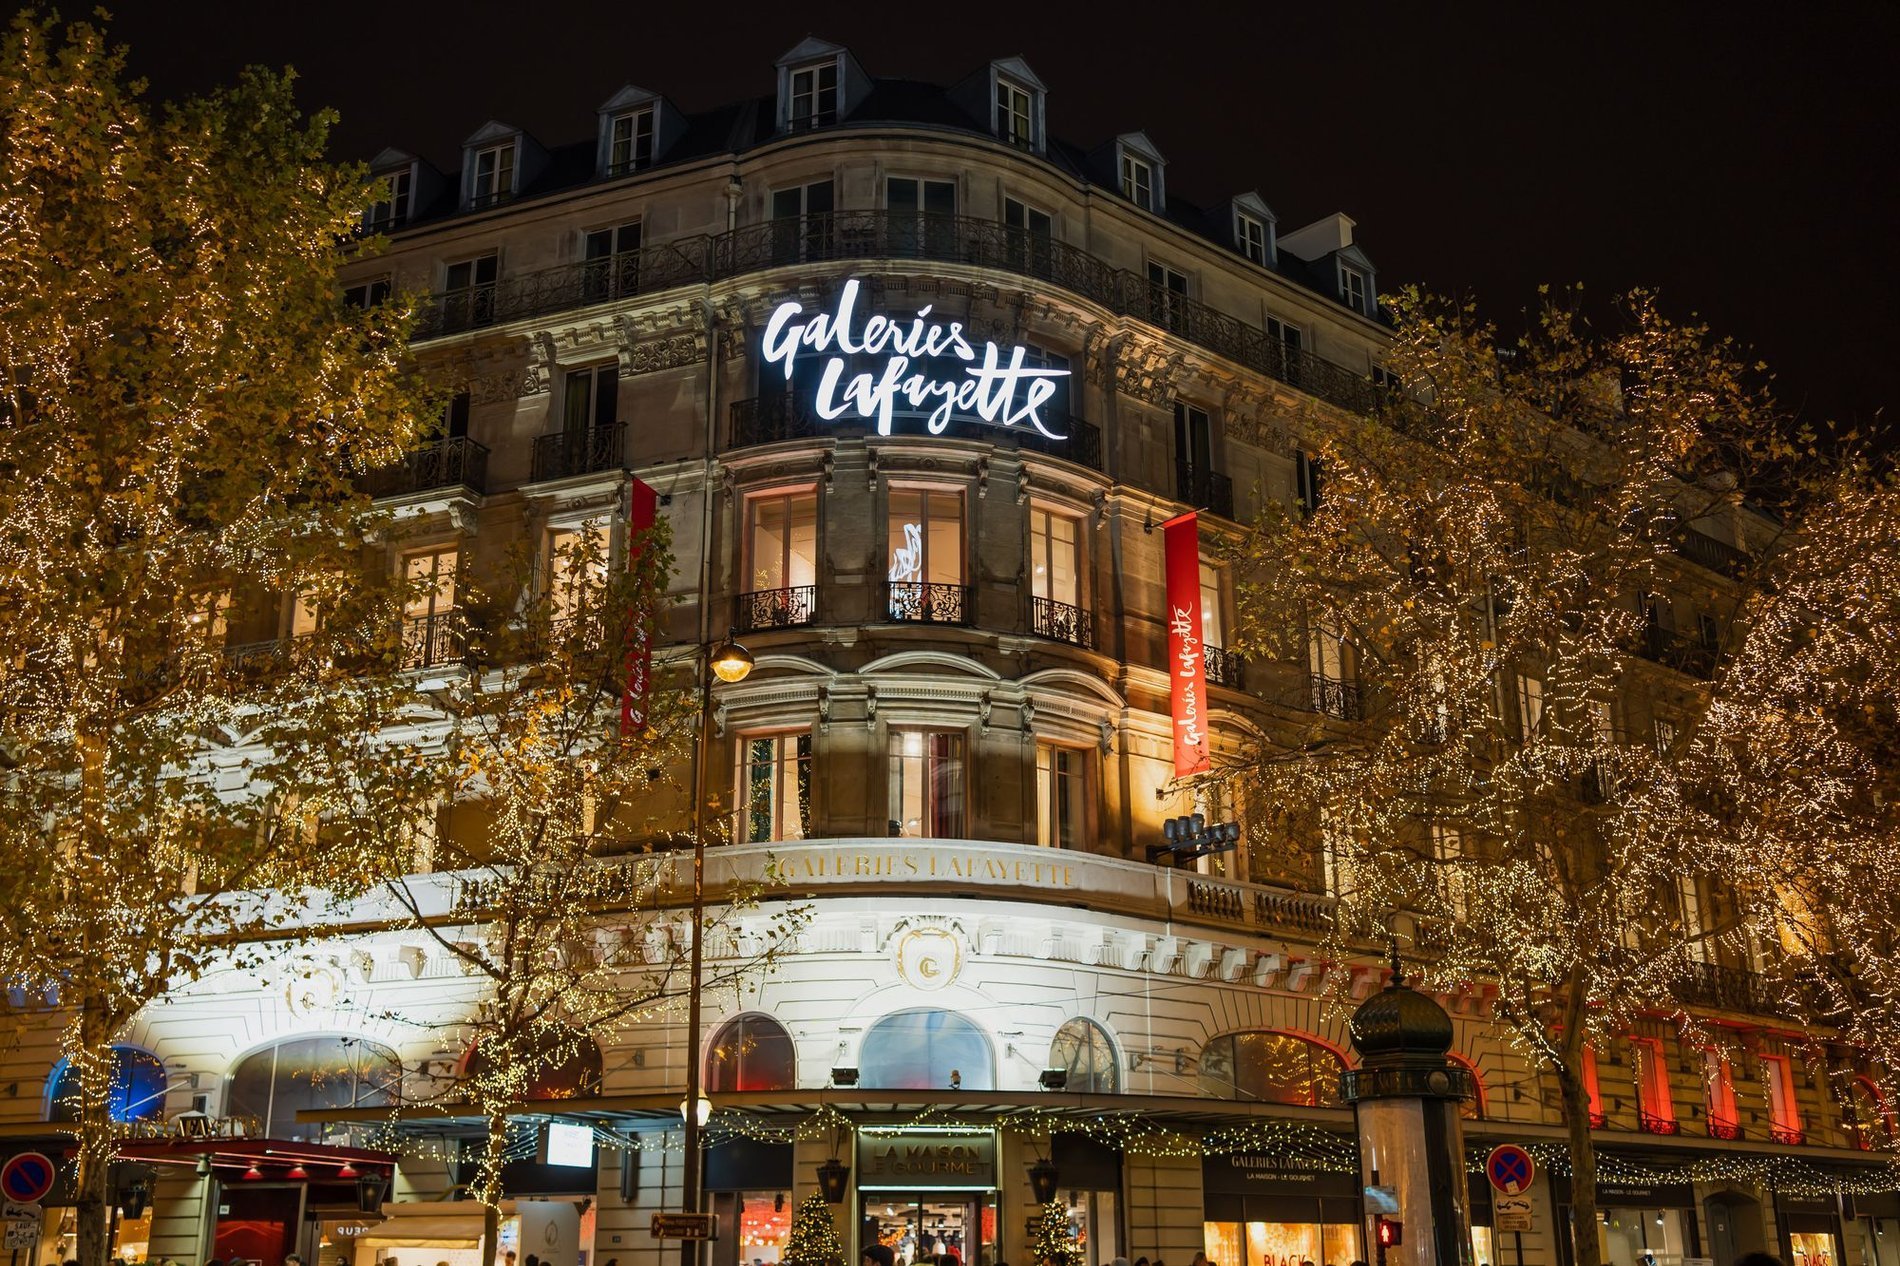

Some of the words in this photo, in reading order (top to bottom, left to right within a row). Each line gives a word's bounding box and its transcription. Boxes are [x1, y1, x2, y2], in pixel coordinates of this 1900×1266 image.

[762, 279, 975, 380] Galeries
[815, 341, 1072, 440] Lafayette
[1171, 601, 1199, 678] Lafayette
[1178, 681, 1204, 746] Galeries
[778, 855, 919, 877] GALERIES
[929, 855, 1074, 885] LAFAYETTE
[873, 1144, 898, 1159] LA
[905, 1144, 980, 1160] MAISON
[891, 1161, 990, 1176] GOURMET
[1231, 1156, 1278, 1168] GALERIES
